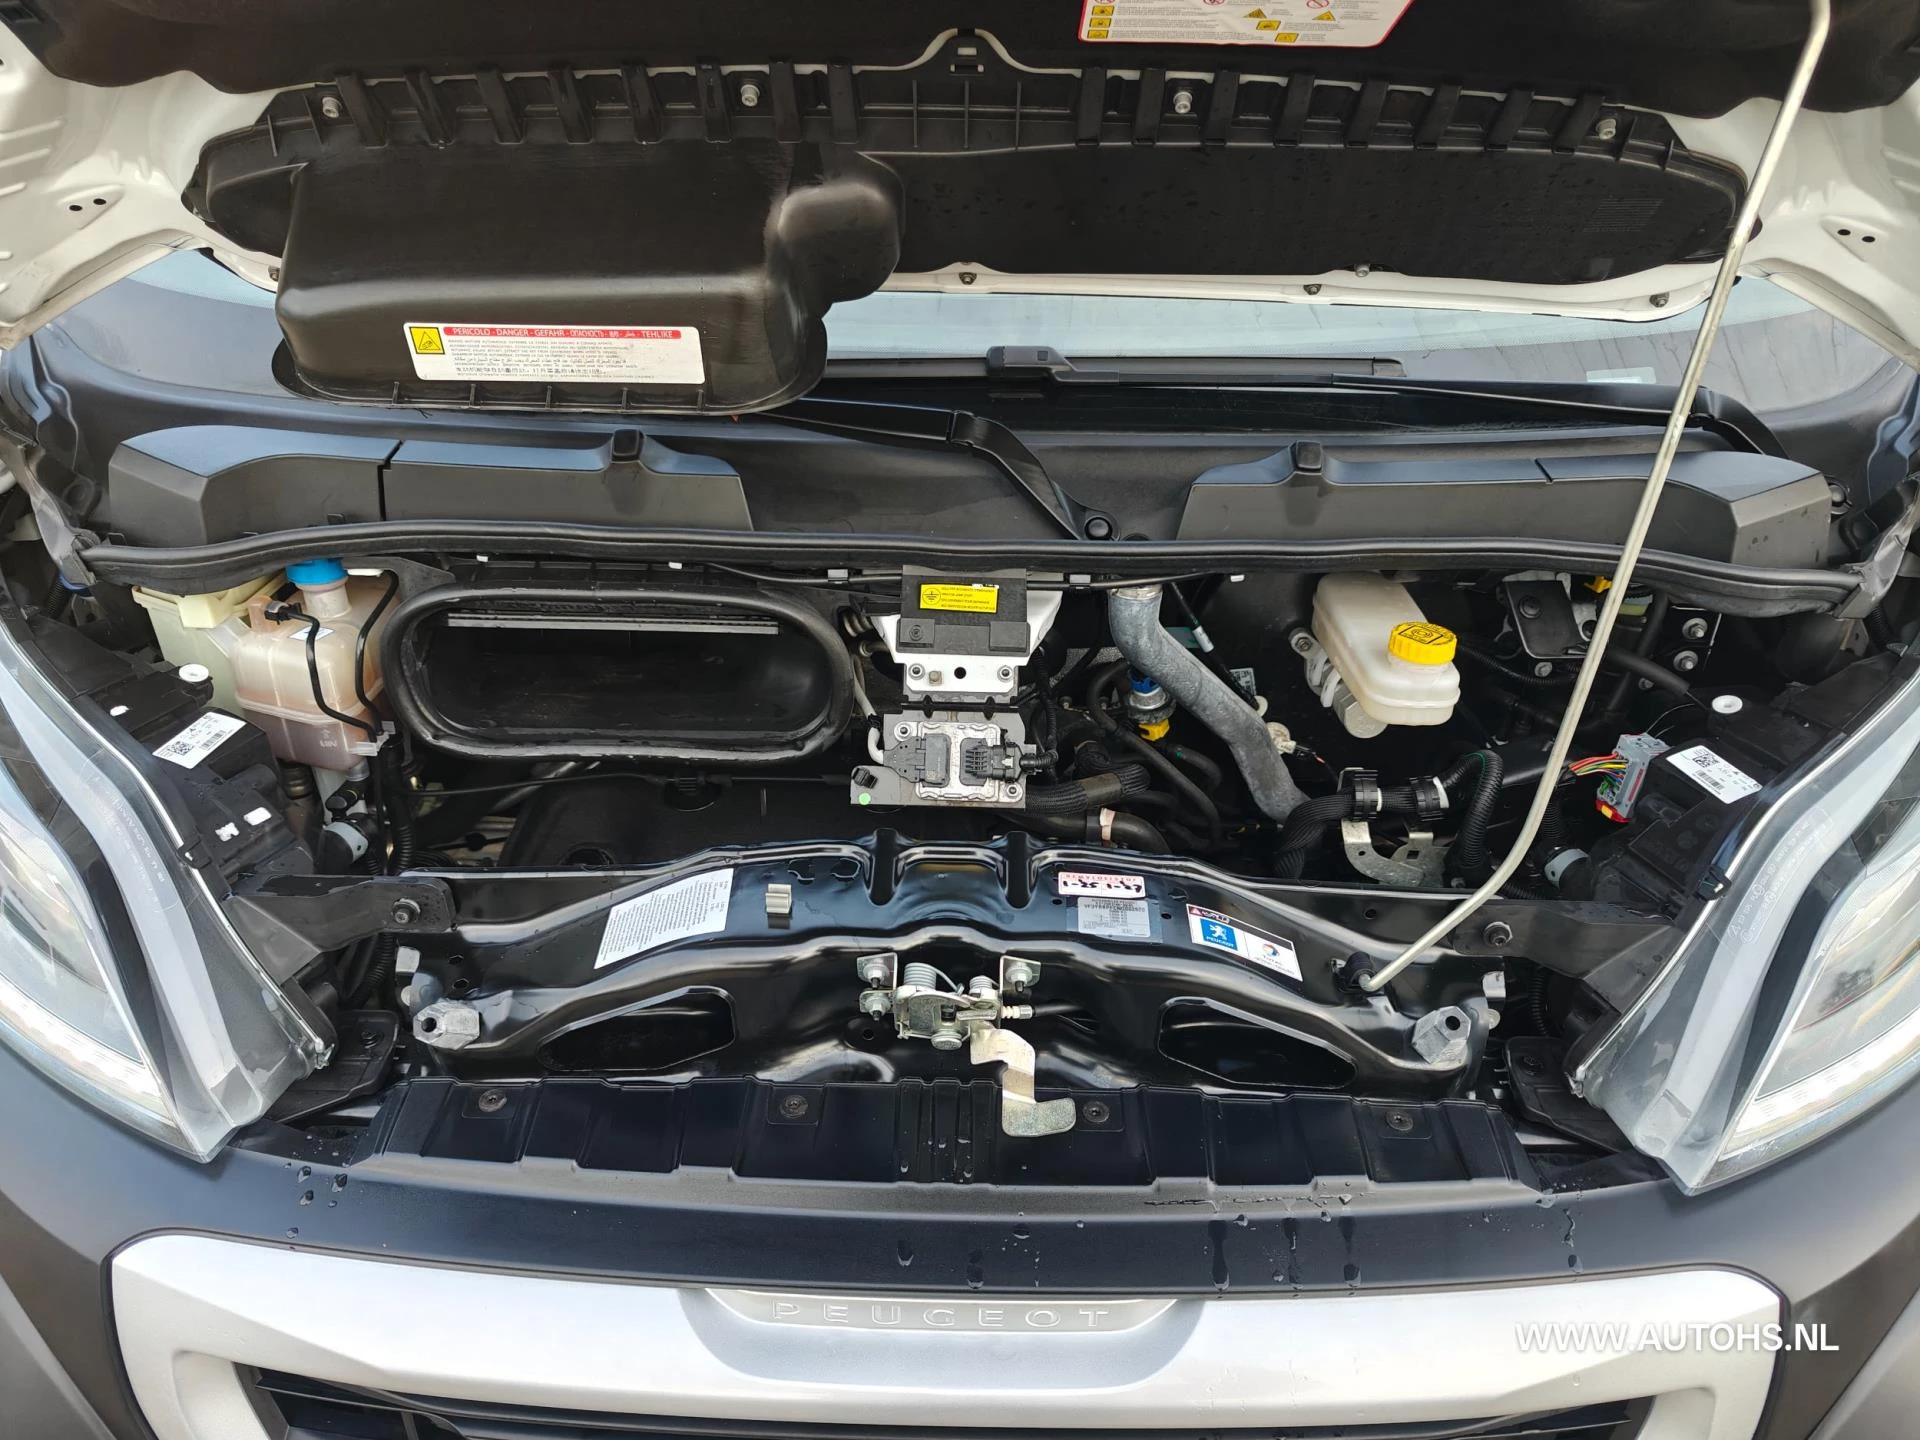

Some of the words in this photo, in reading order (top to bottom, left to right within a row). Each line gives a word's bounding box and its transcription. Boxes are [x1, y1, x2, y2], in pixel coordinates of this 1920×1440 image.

[452, 327, 490, 336] PERICOLO
[496, 328, 529, 337] DANGER
[534, 329, 565, 337] GEFAHR
[641, 331, 673, 339] TEHLIKE
[771, 1300, 1109, 1328] PEUGEOT
